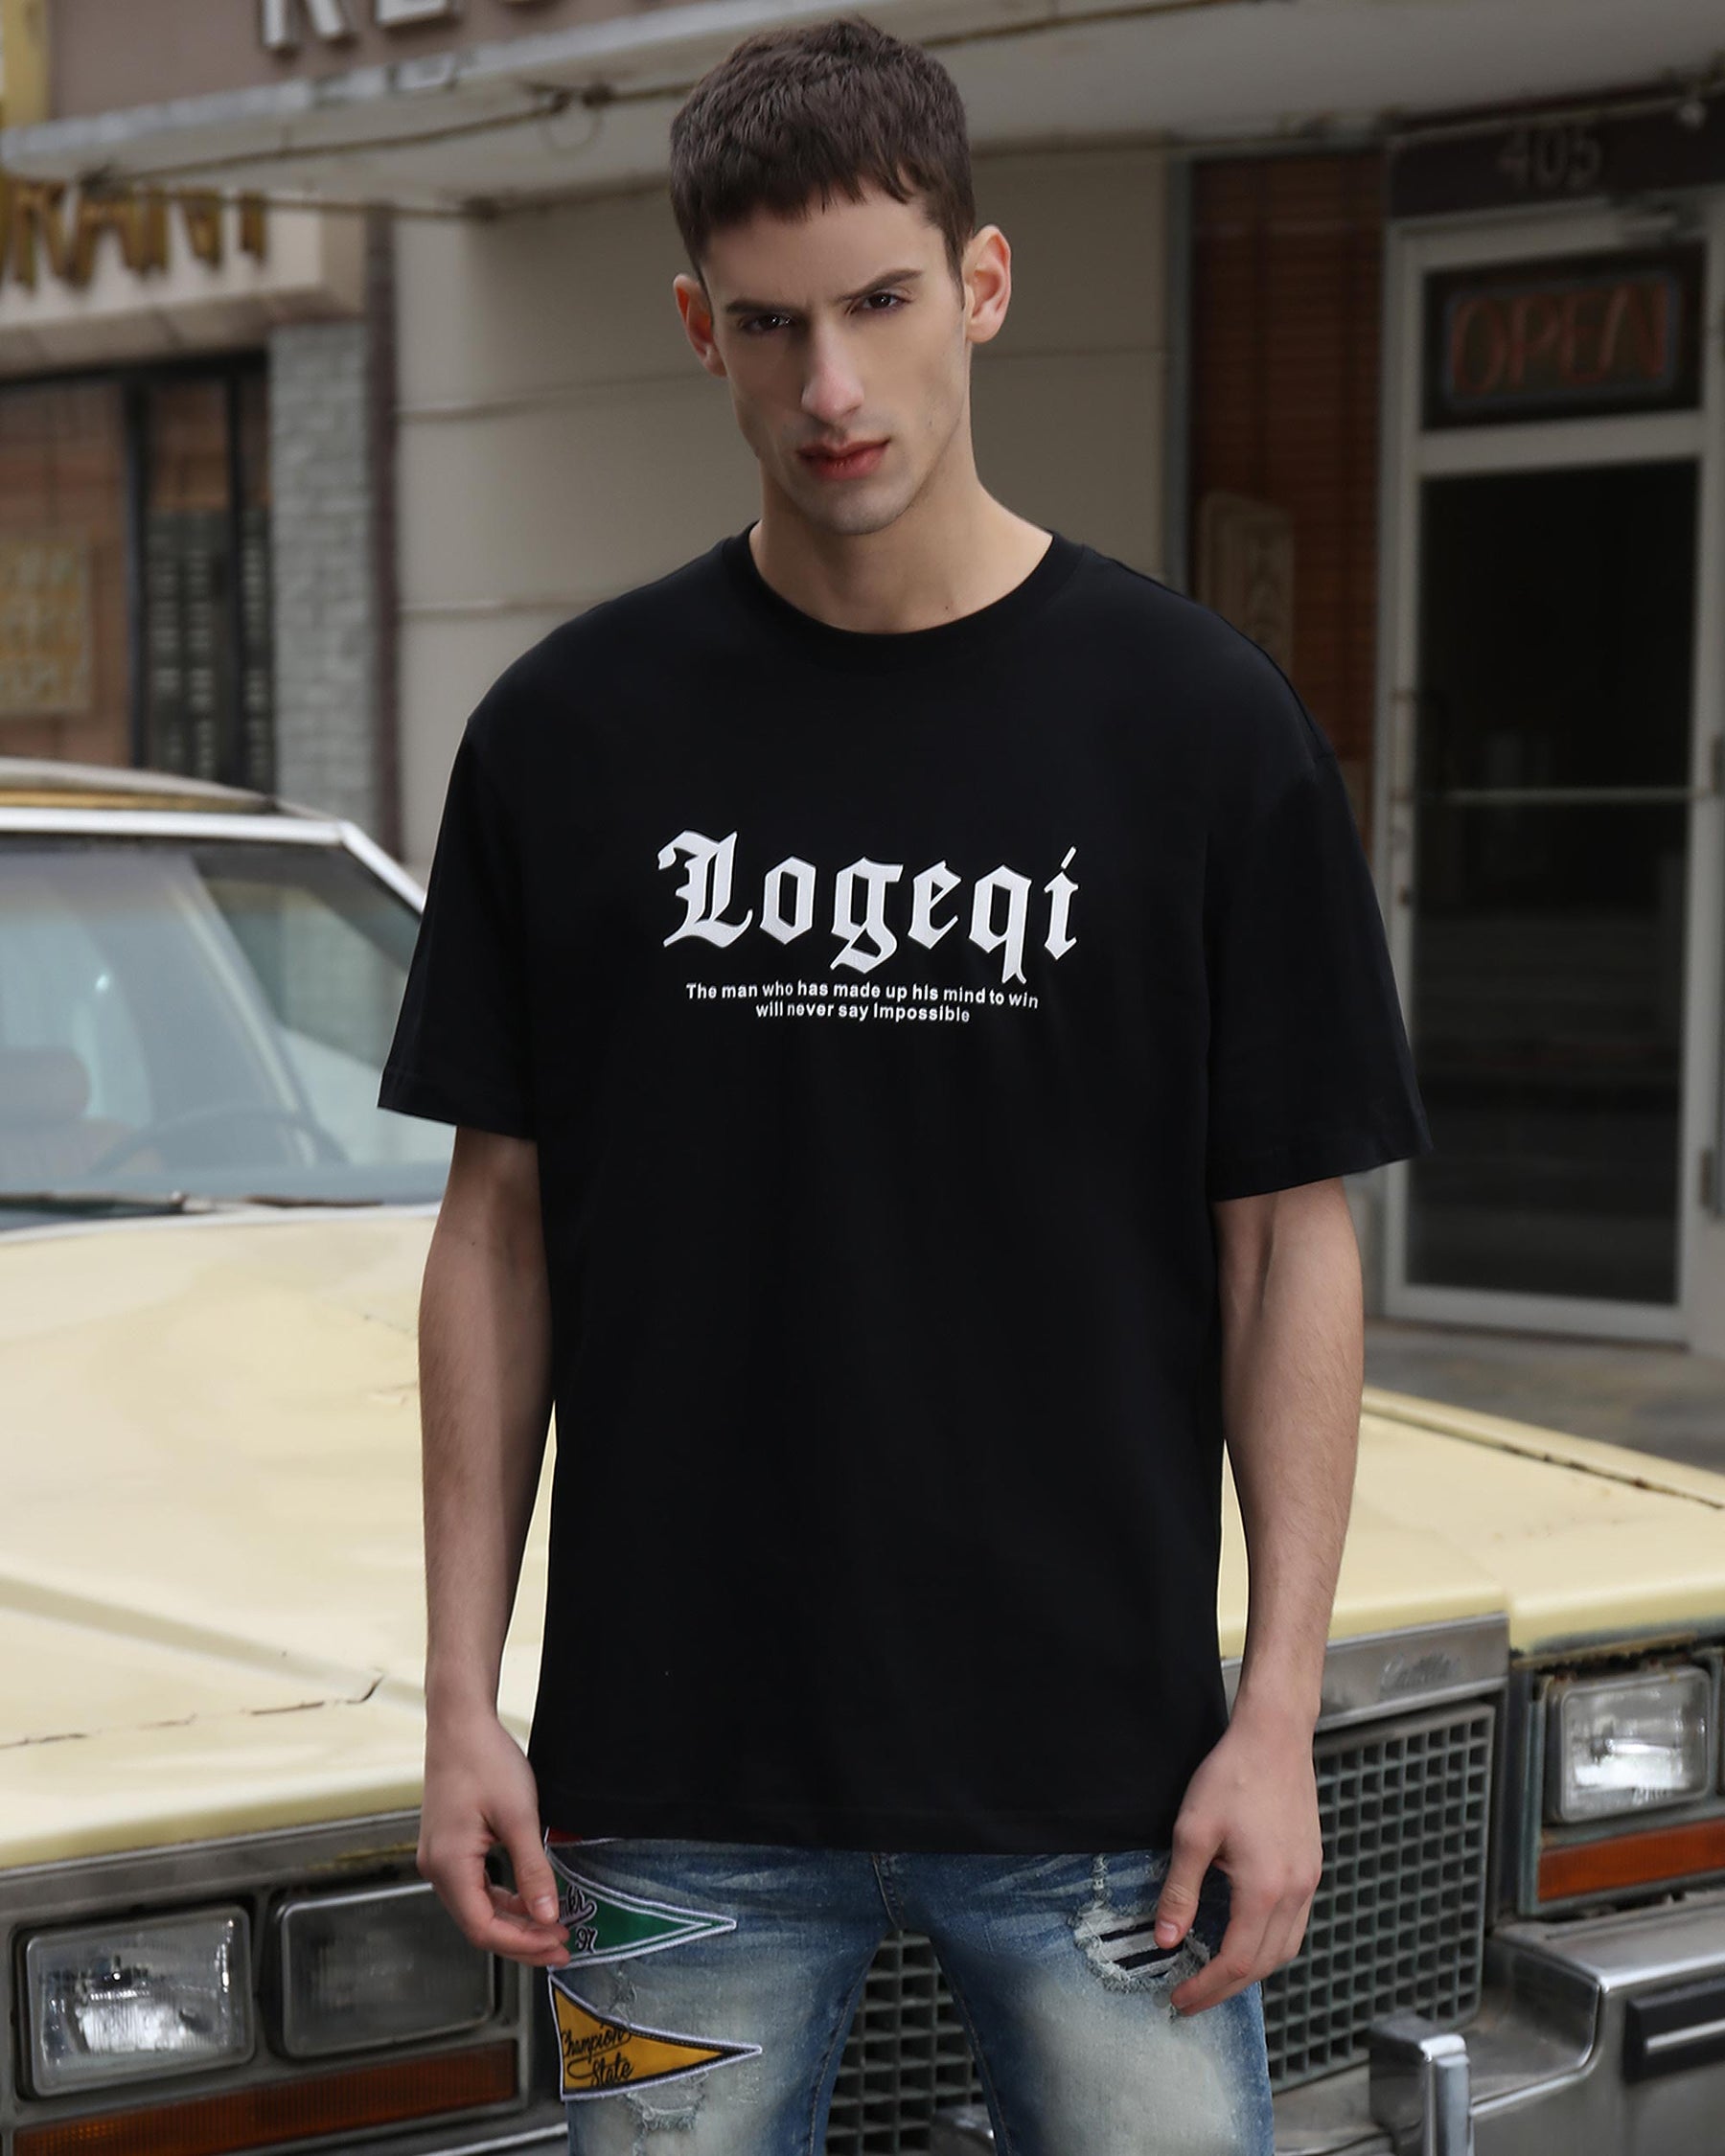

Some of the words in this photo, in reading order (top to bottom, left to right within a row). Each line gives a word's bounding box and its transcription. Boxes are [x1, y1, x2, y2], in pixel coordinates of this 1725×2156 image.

[1497, 129, 1602, 189] 405
[1451, 281, 1667, 395] OPEN
[657, 830, 1078, 985] Logeqi
[686, 982, 717, 999] The
[722, 984, 758, 999] man
[762, 980, 794, 998] who
[797, 979, 829, 998] has
[834, 981, 881, 998] made
[886, 985, 908, 1003] up
[912, 983, 939, 1001] his
[943, 987, 986, 1004] mind
[989, 988, 1005, 1006] to
[1008, 992, 1039, 1009] win
[755, 1000, 784, 1018] will
[787, 1003, 835, 1018] never
[838, 1004, 869, 1022] say
